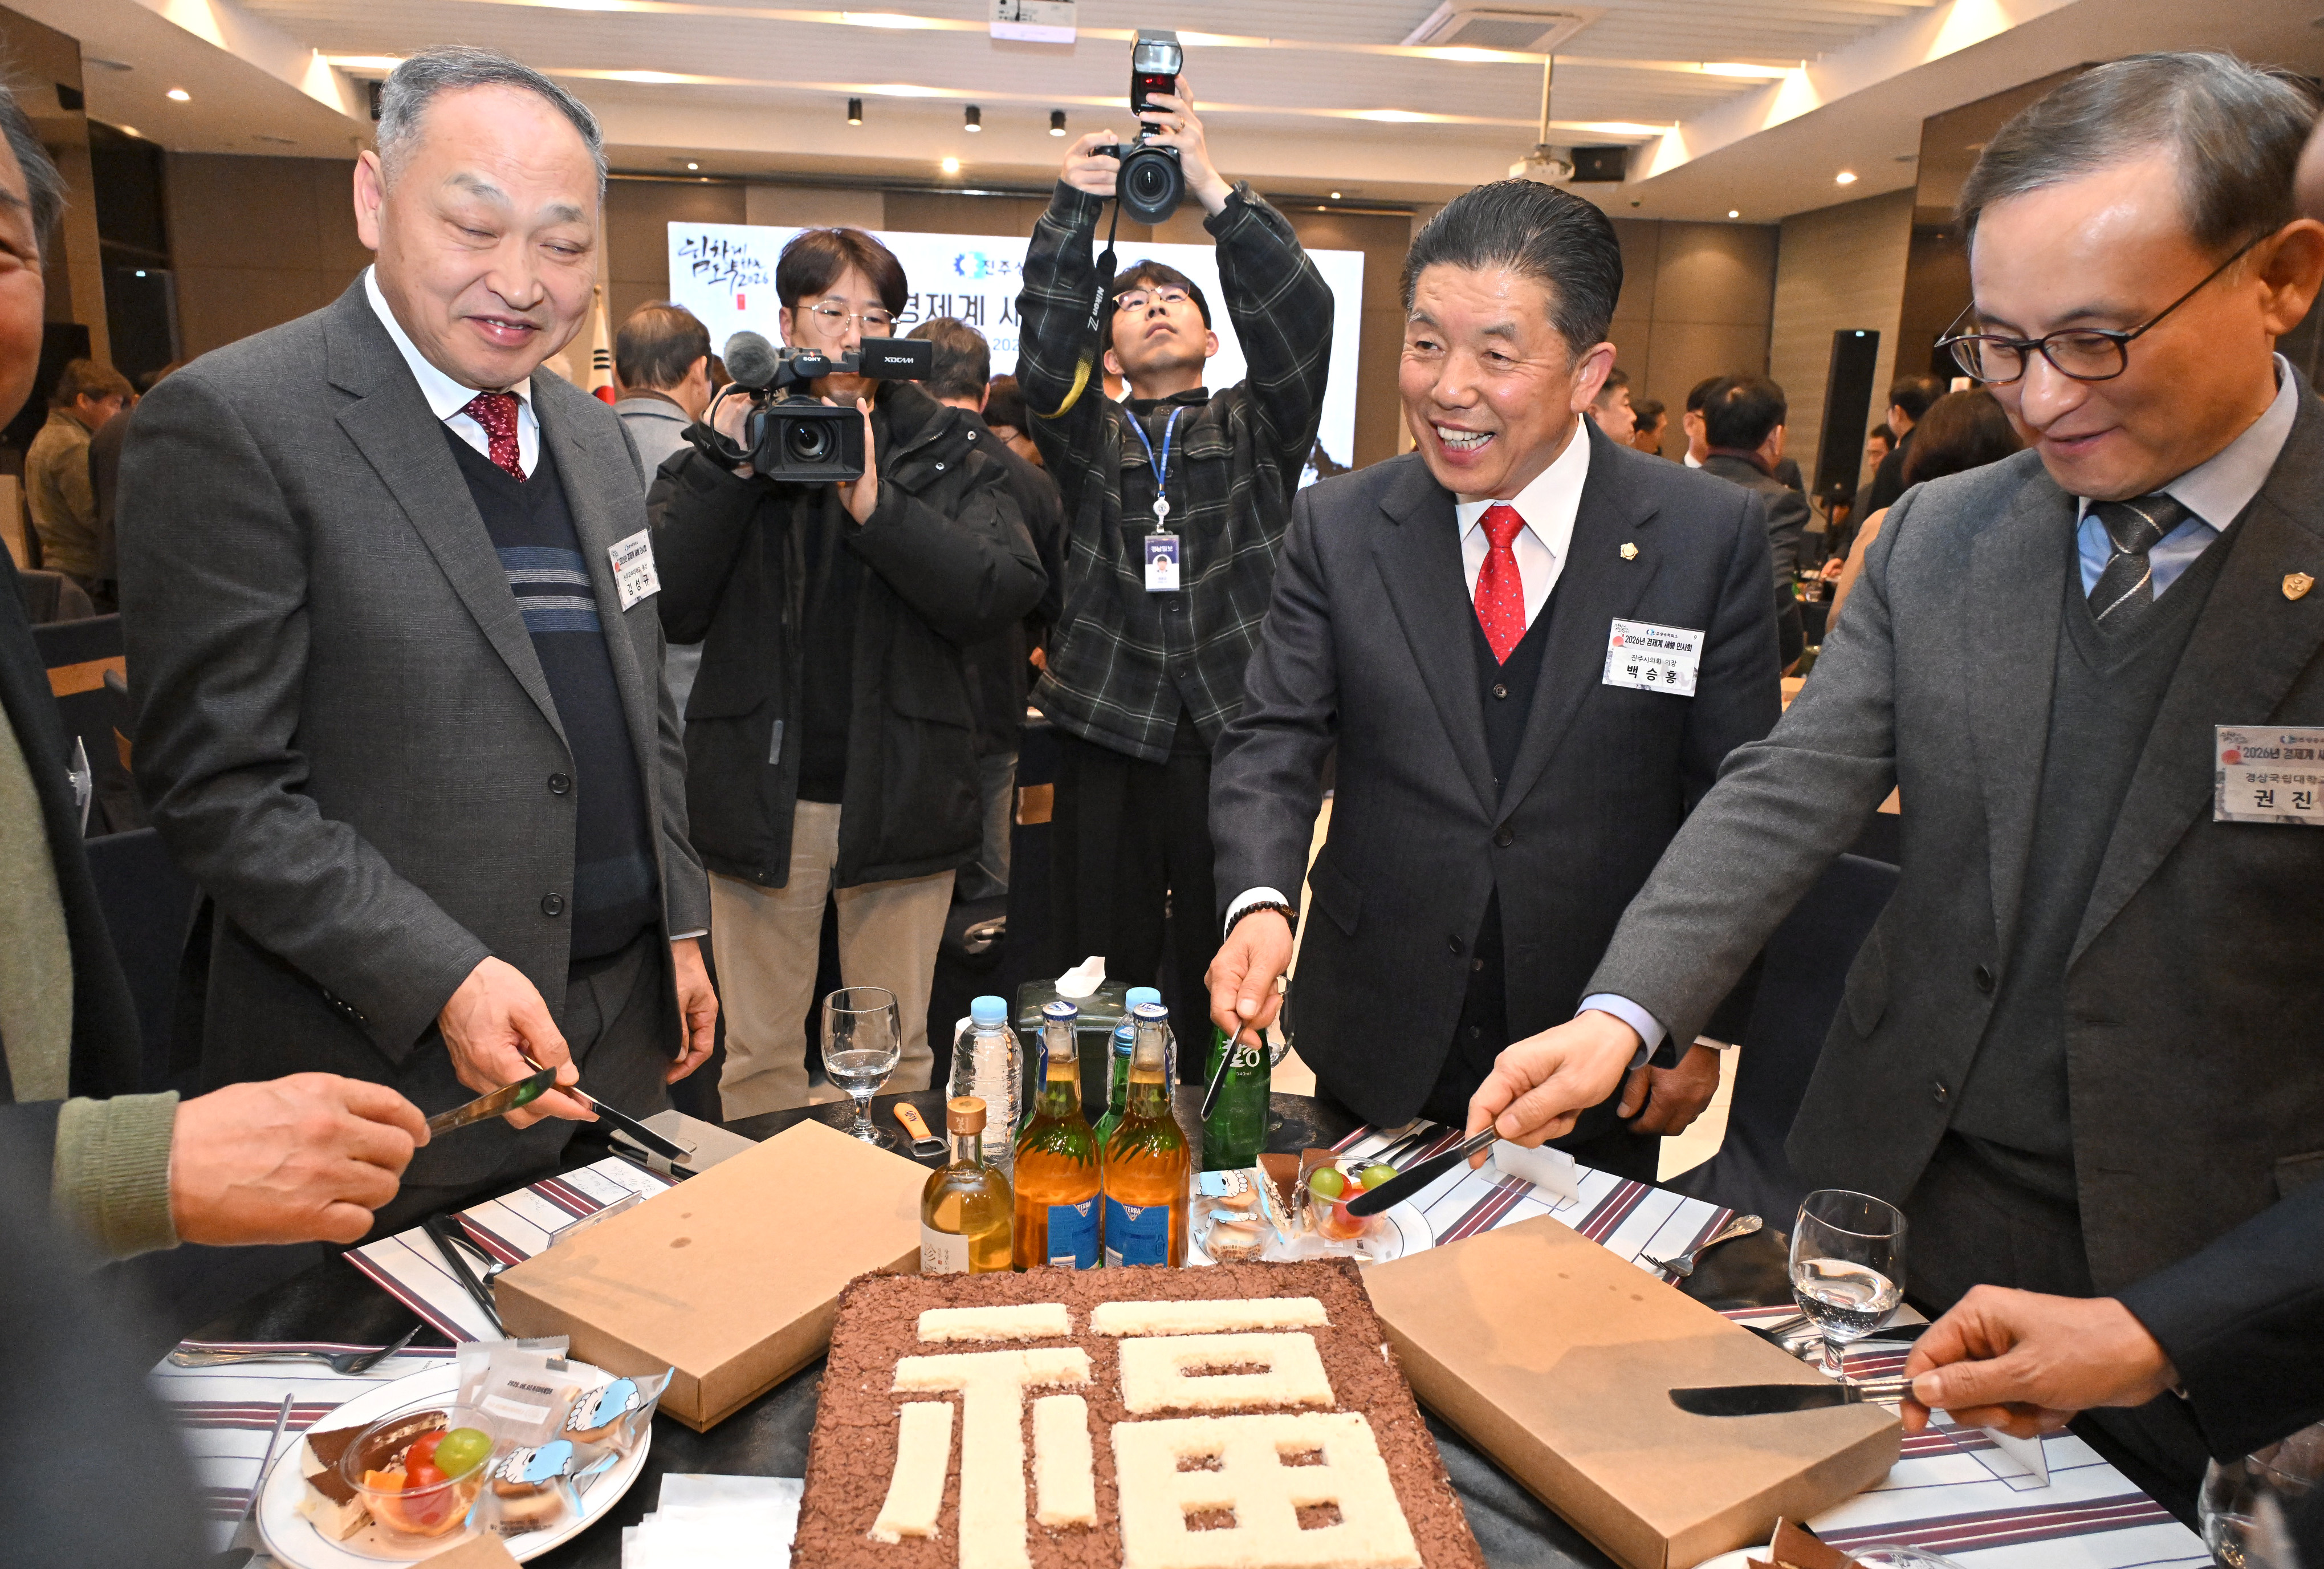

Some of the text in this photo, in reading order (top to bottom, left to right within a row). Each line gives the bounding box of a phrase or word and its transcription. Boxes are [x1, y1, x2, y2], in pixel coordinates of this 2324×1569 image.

[1092, 286, 1104, 316] Nikon
[1625, 635, 1693, 652] 2026년 경제계 새해 인사회
[1631, 655, 1662, 665] 진주시의회
[1627, 665, 1639, 679] 백
[1646, 668, 1658, 681] 승
[2243, 747, 2280, 759] 2026년
[2254, 789, 2311, 810] 권 진
[905, 1110, 919, 1122] Kelly
[1077, 1201, 1091, 1211] TERRA
[1124, 1205, 1141, 1215] TERRA
[865, 1296, 1425, 1569] 福
